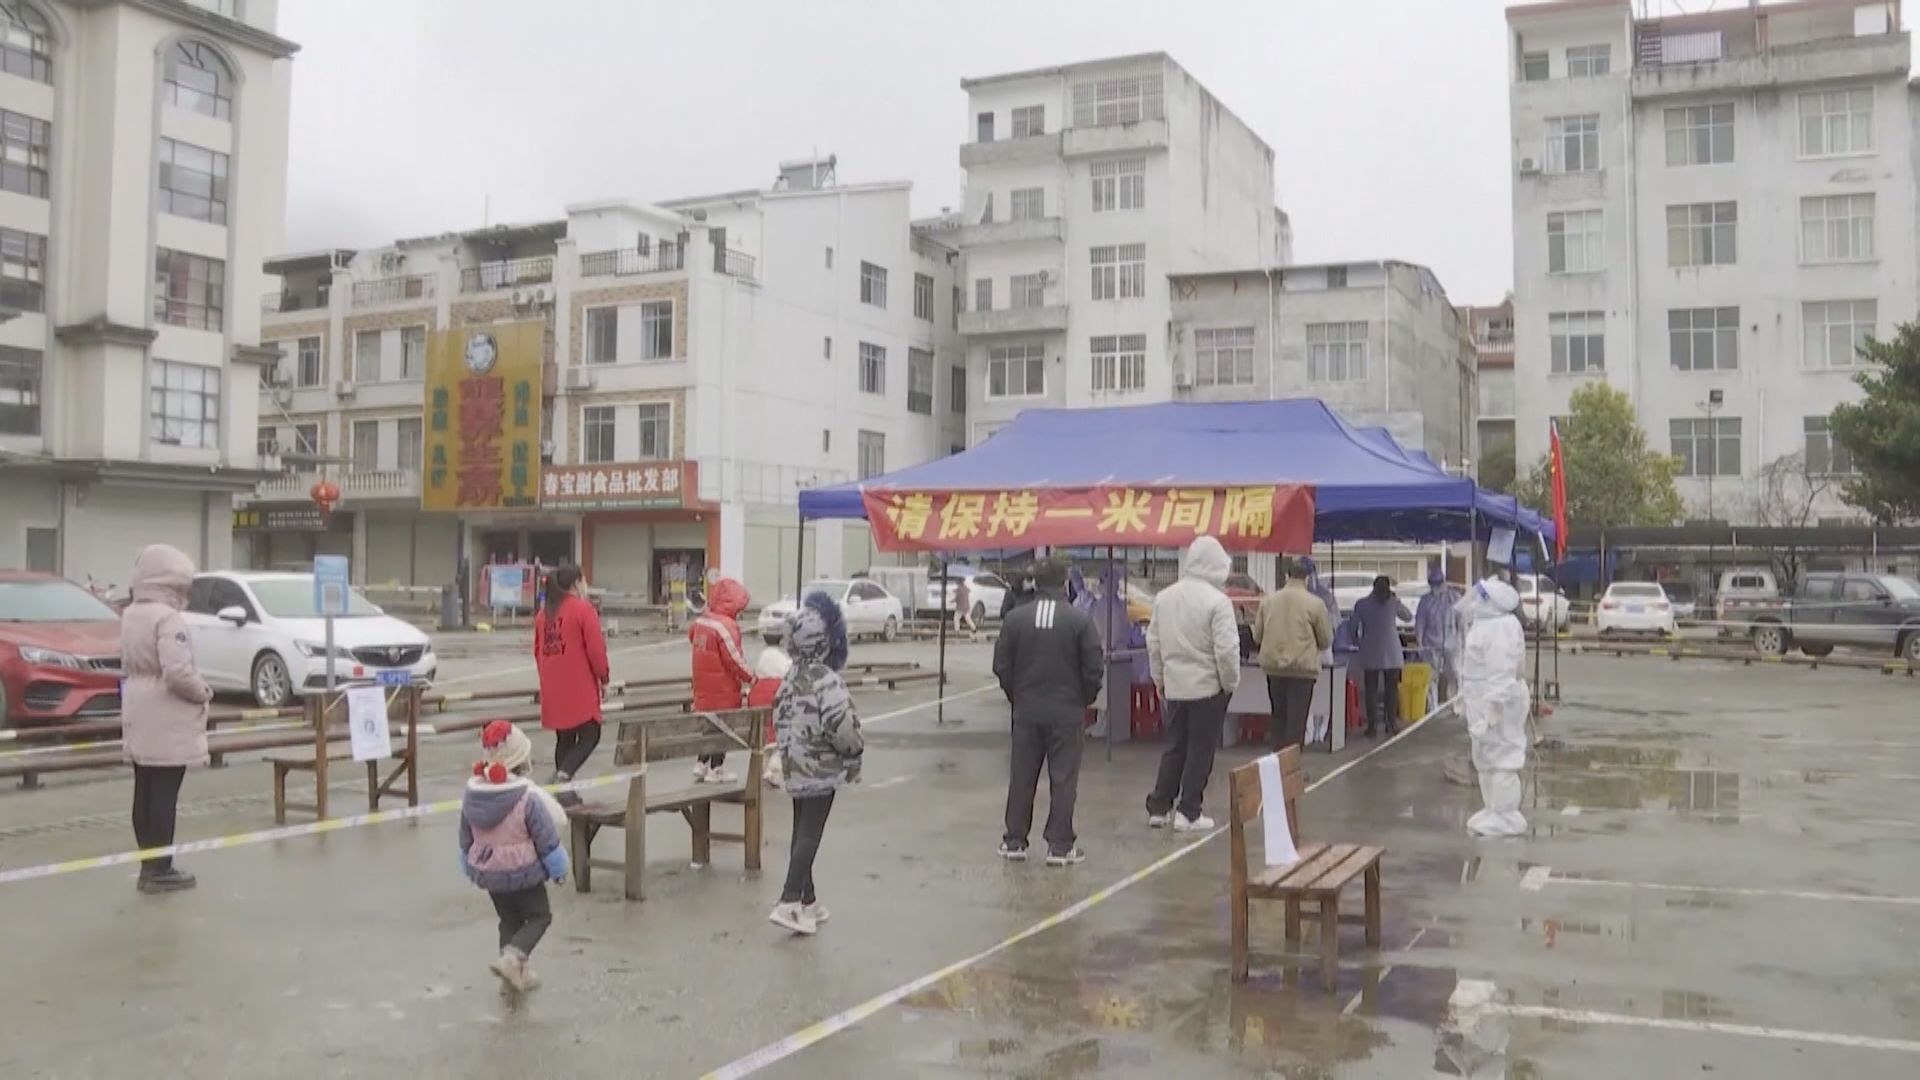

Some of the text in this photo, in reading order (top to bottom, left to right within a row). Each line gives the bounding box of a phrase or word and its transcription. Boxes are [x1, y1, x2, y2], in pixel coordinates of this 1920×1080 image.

[886, 487, 1277, 541] 请保持一米间隔
